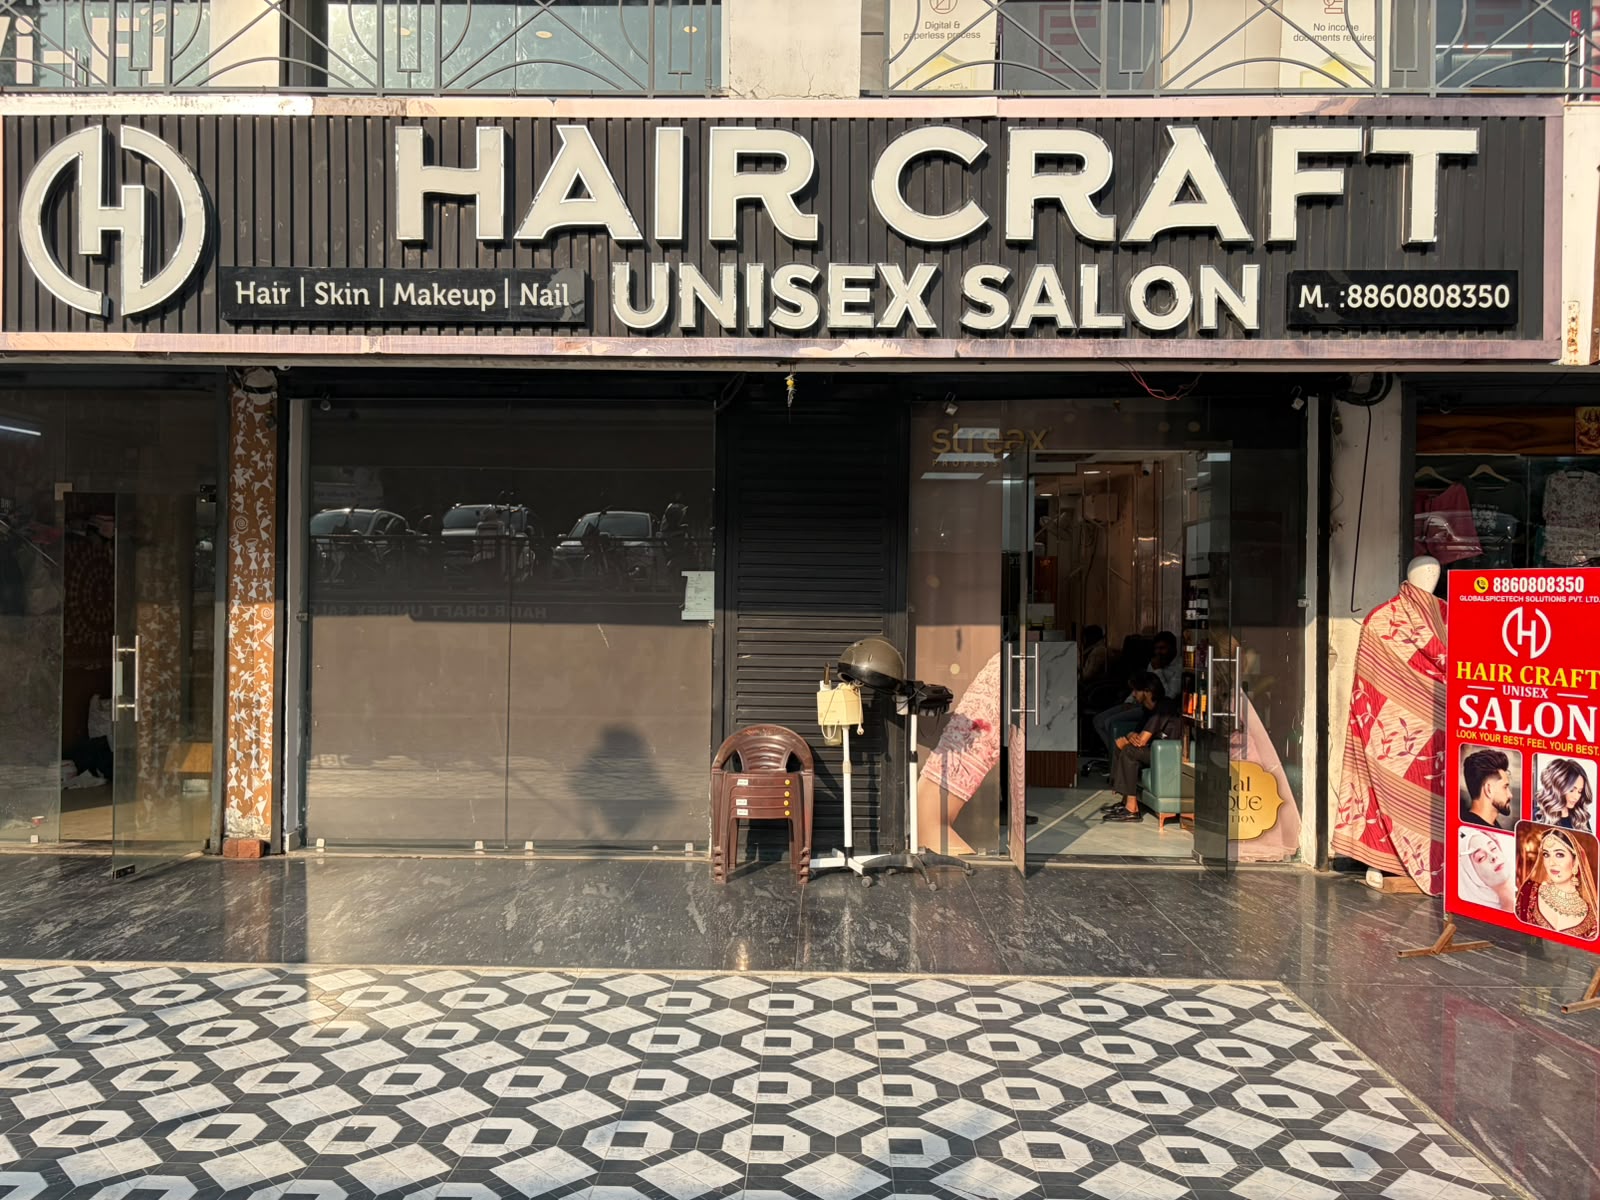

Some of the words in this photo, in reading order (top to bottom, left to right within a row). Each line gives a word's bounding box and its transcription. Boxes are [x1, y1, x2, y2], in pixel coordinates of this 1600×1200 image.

[925, 21, 951, 31] Digital
[953, 21, 960, 29] &
[1293, 33, 1341, 42] docments
[1343, 33, 1376, 42] reuire
[1313, 23, 1326, 31] No
[394, 124, 820, 243] HAIR
[870, 124, 1480, 244] CRAFT
[235, 280, 292, 305] Hair
[314, 281, 370, 306] Skin
[393, 282, 496, 312] Makeup
[520, 282, 570, 307] Nail
[611, 261, 939, 332] UNISEX
[959, 261, 1261, 332] SALON
[1298, 284, 1329, 309] M.
[1493, 576, 1585, 593] 8860808350
[1459, 595, 1524, 603] GLOBALSPICETECH
[1525, 595, 1567, 603] SOLUTIONS
[1568, 595, 1584, 603] PVT.
[1456, 661, 1514, 684] HAIR
[1519, 666, 1600, 690] CRAFT
[1502, 684, 1549, 699] UNISEX
[1458, 694, 1598, 743] SALON
[1456, 729, 1478, 740] LOOK
[1479, 732, 1501, 743] YOUR
[1527, 738, 1548, 750] FEEL
[1549, 741, 1574, 752] YOUR
